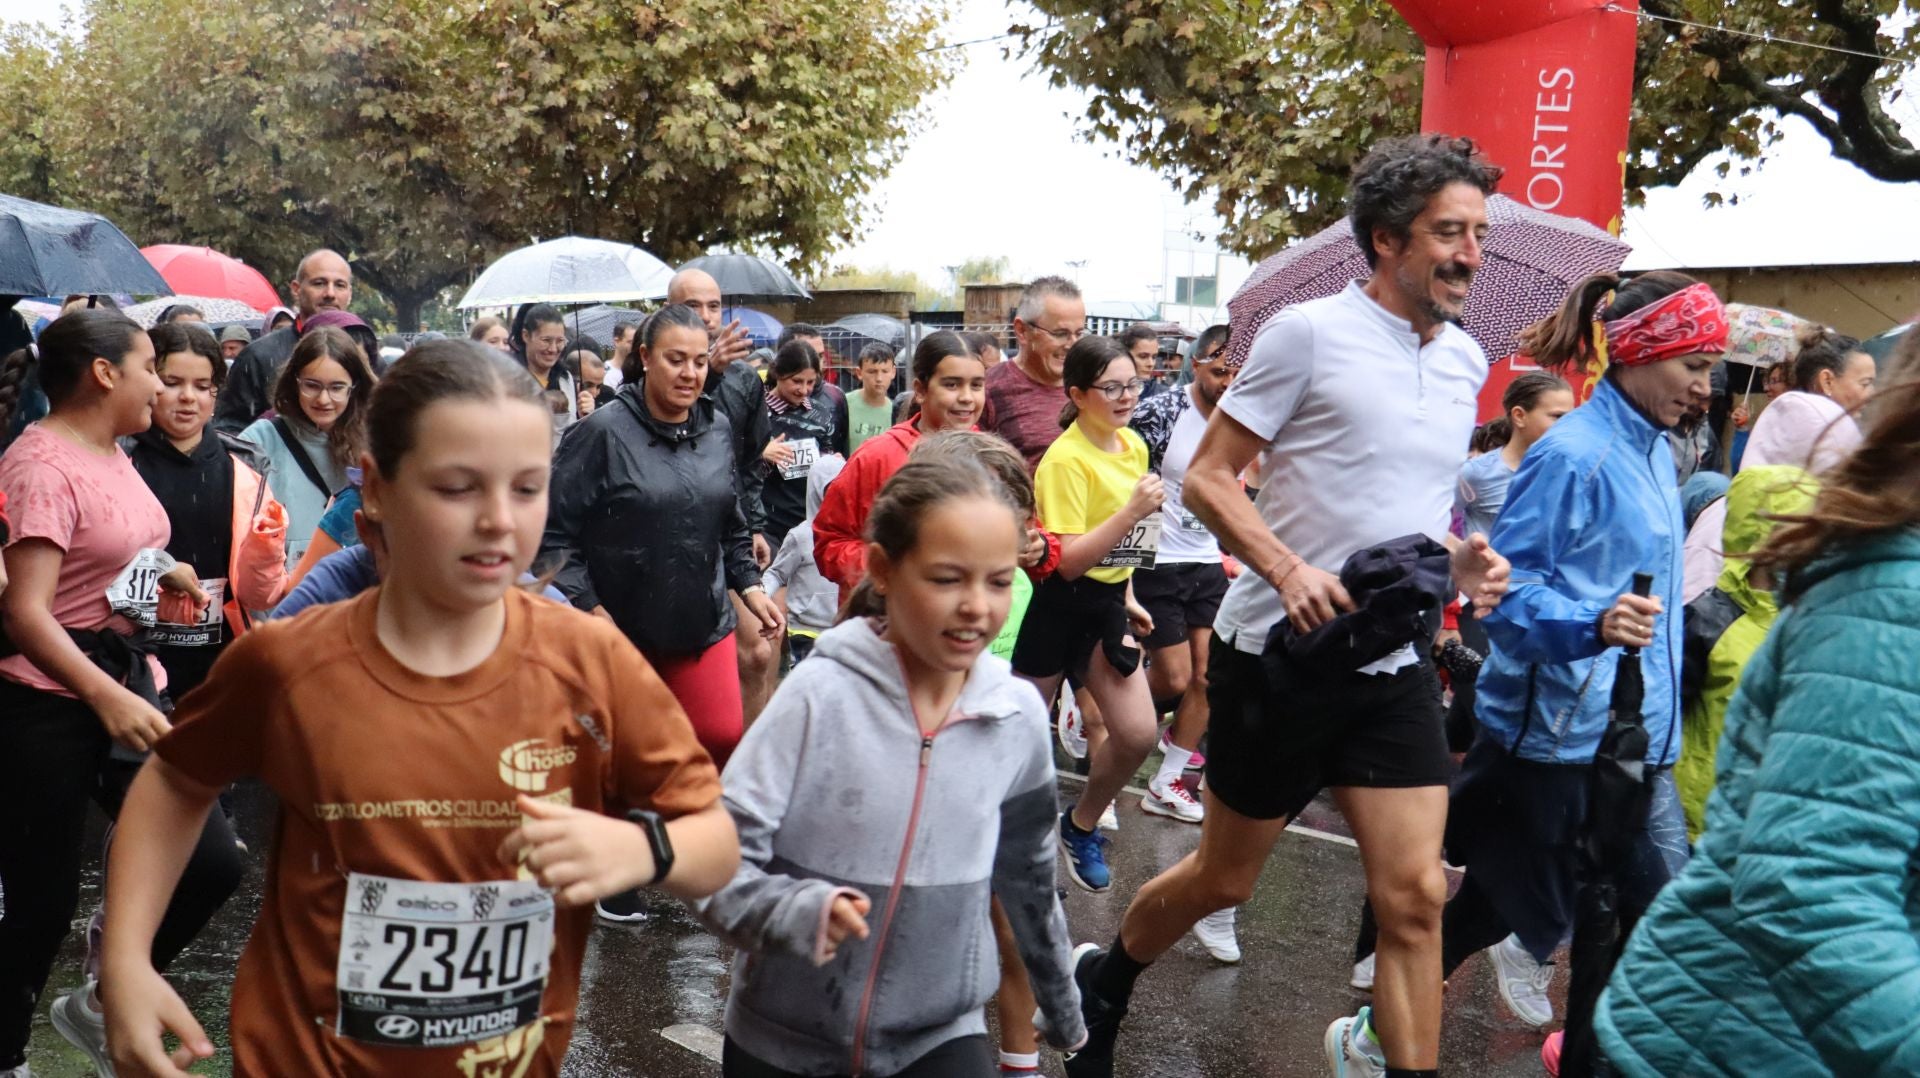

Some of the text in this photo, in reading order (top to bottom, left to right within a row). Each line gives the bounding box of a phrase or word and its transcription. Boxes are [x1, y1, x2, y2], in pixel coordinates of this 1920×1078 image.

[1527, 67, 1575, 210] ORTES
[1116, 526, 1146, 549] 82
[169, 632, 210, 642] HYUNDAI
[379, 921, 529, 992] 2340
[424, 1007, 519, 1037] HYUNDAI
[1341, 1023, 1352, 1062] HOKA
